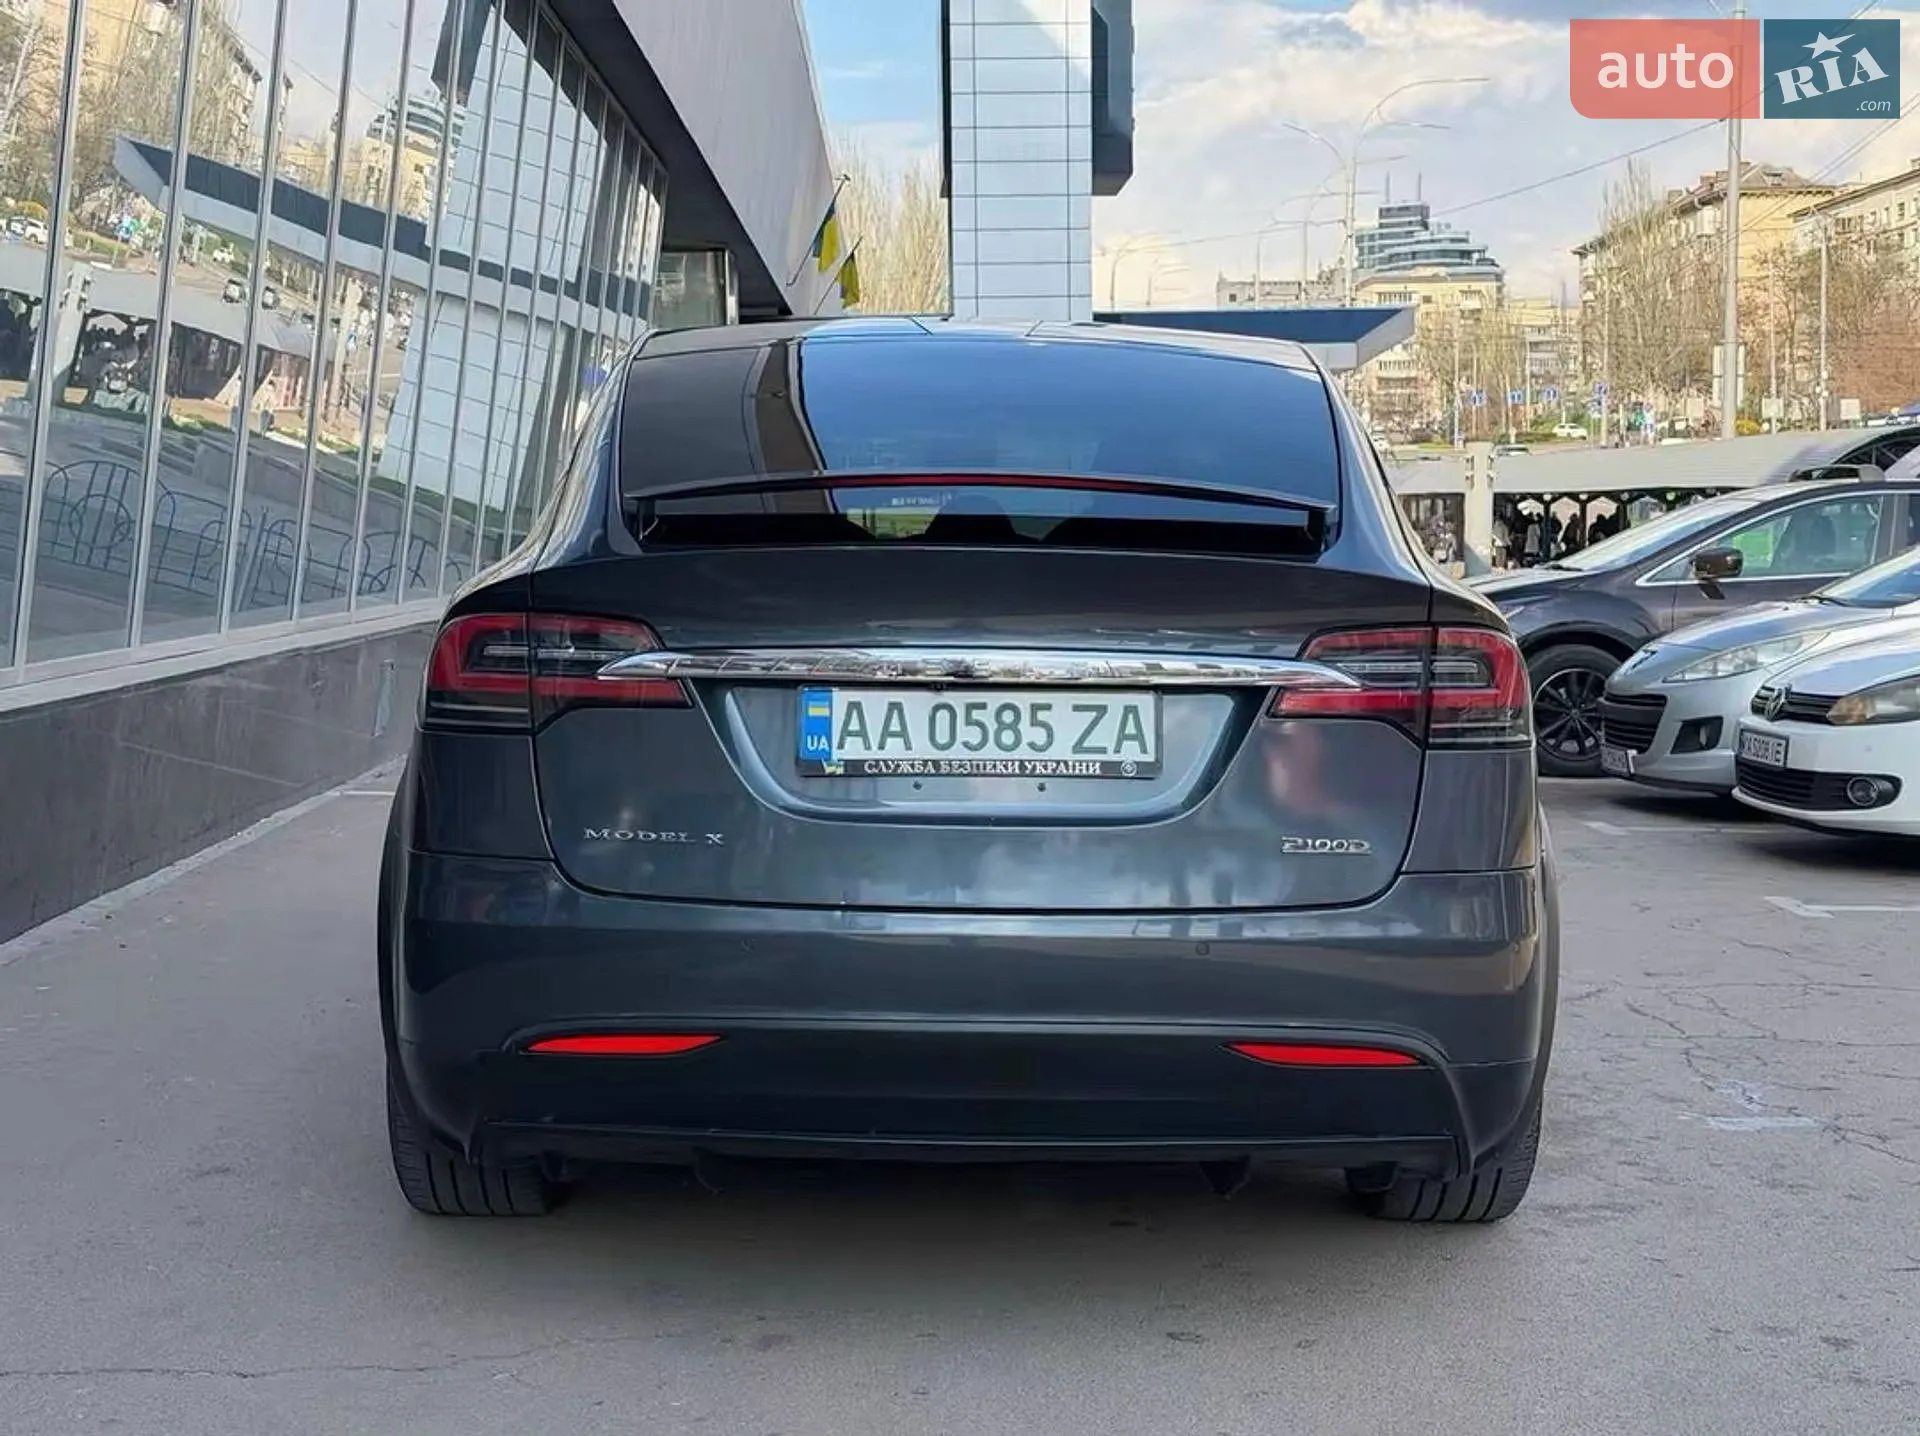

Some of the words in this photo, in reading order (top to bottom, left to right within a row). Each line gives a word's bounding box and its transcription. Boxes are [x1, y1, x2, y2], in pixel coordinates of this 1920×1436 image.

[837, 699, 914, 752] AA
[927, 701, 1055, 754] 0585
[1070, 703, 1149, 755] ZA
[806, 735, 830, 751] UA
[863, 760, 936, 774] СЛУЖБА
[939, 760, 1020, 775] БЕЗПЕКИ
[583, 827, 698, 843] MODEL
[705, 832, 725, 846] X
